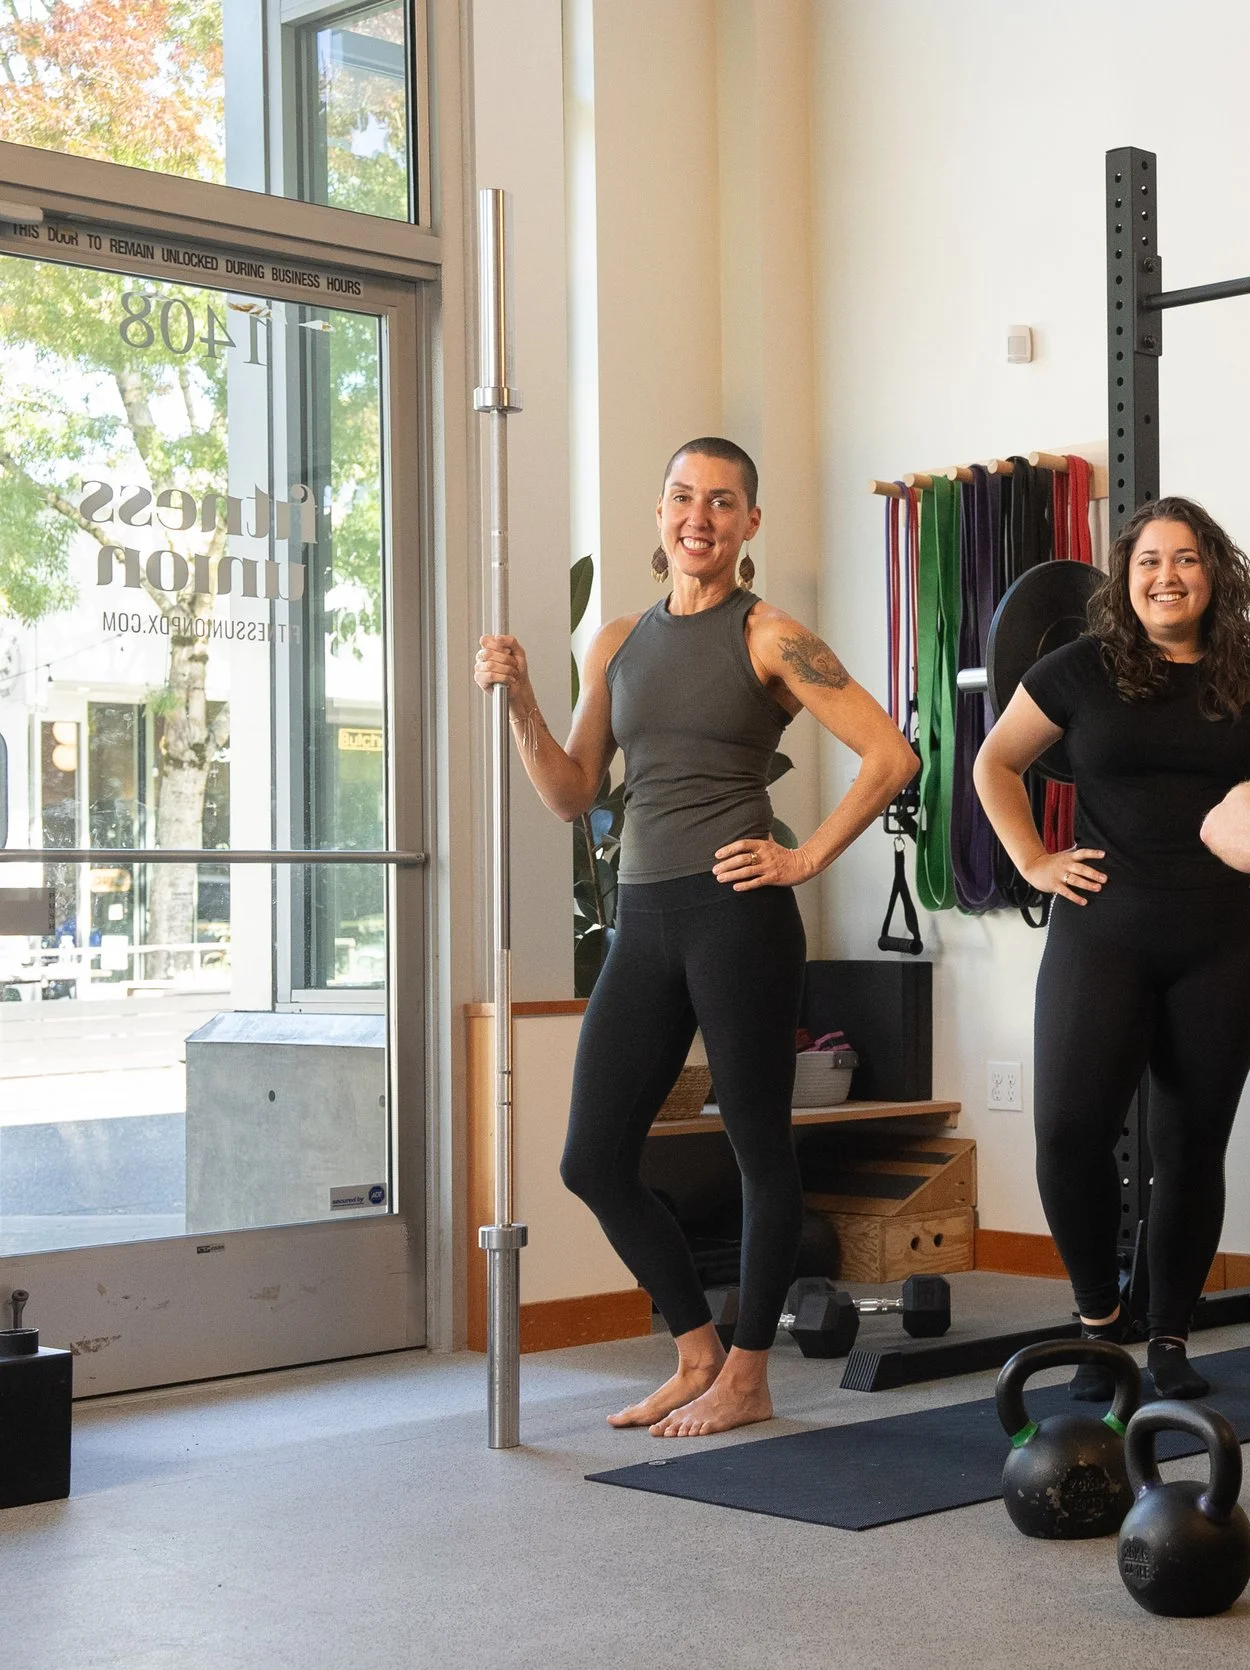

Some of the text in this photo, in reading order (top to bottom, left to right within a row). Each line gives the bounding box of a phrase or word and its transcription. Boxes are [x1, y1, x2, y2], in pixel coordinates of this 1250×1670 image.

[87, 234, 102, 250] TO
[109, 238, 155, 260] REMAIN
[161, 247, 219, 271] UNLOCKED
[225, 259, 265, 280] DURING
[271, 267, 320, 289] BUSINESS
[326, 276, 361, 296] HOURS
